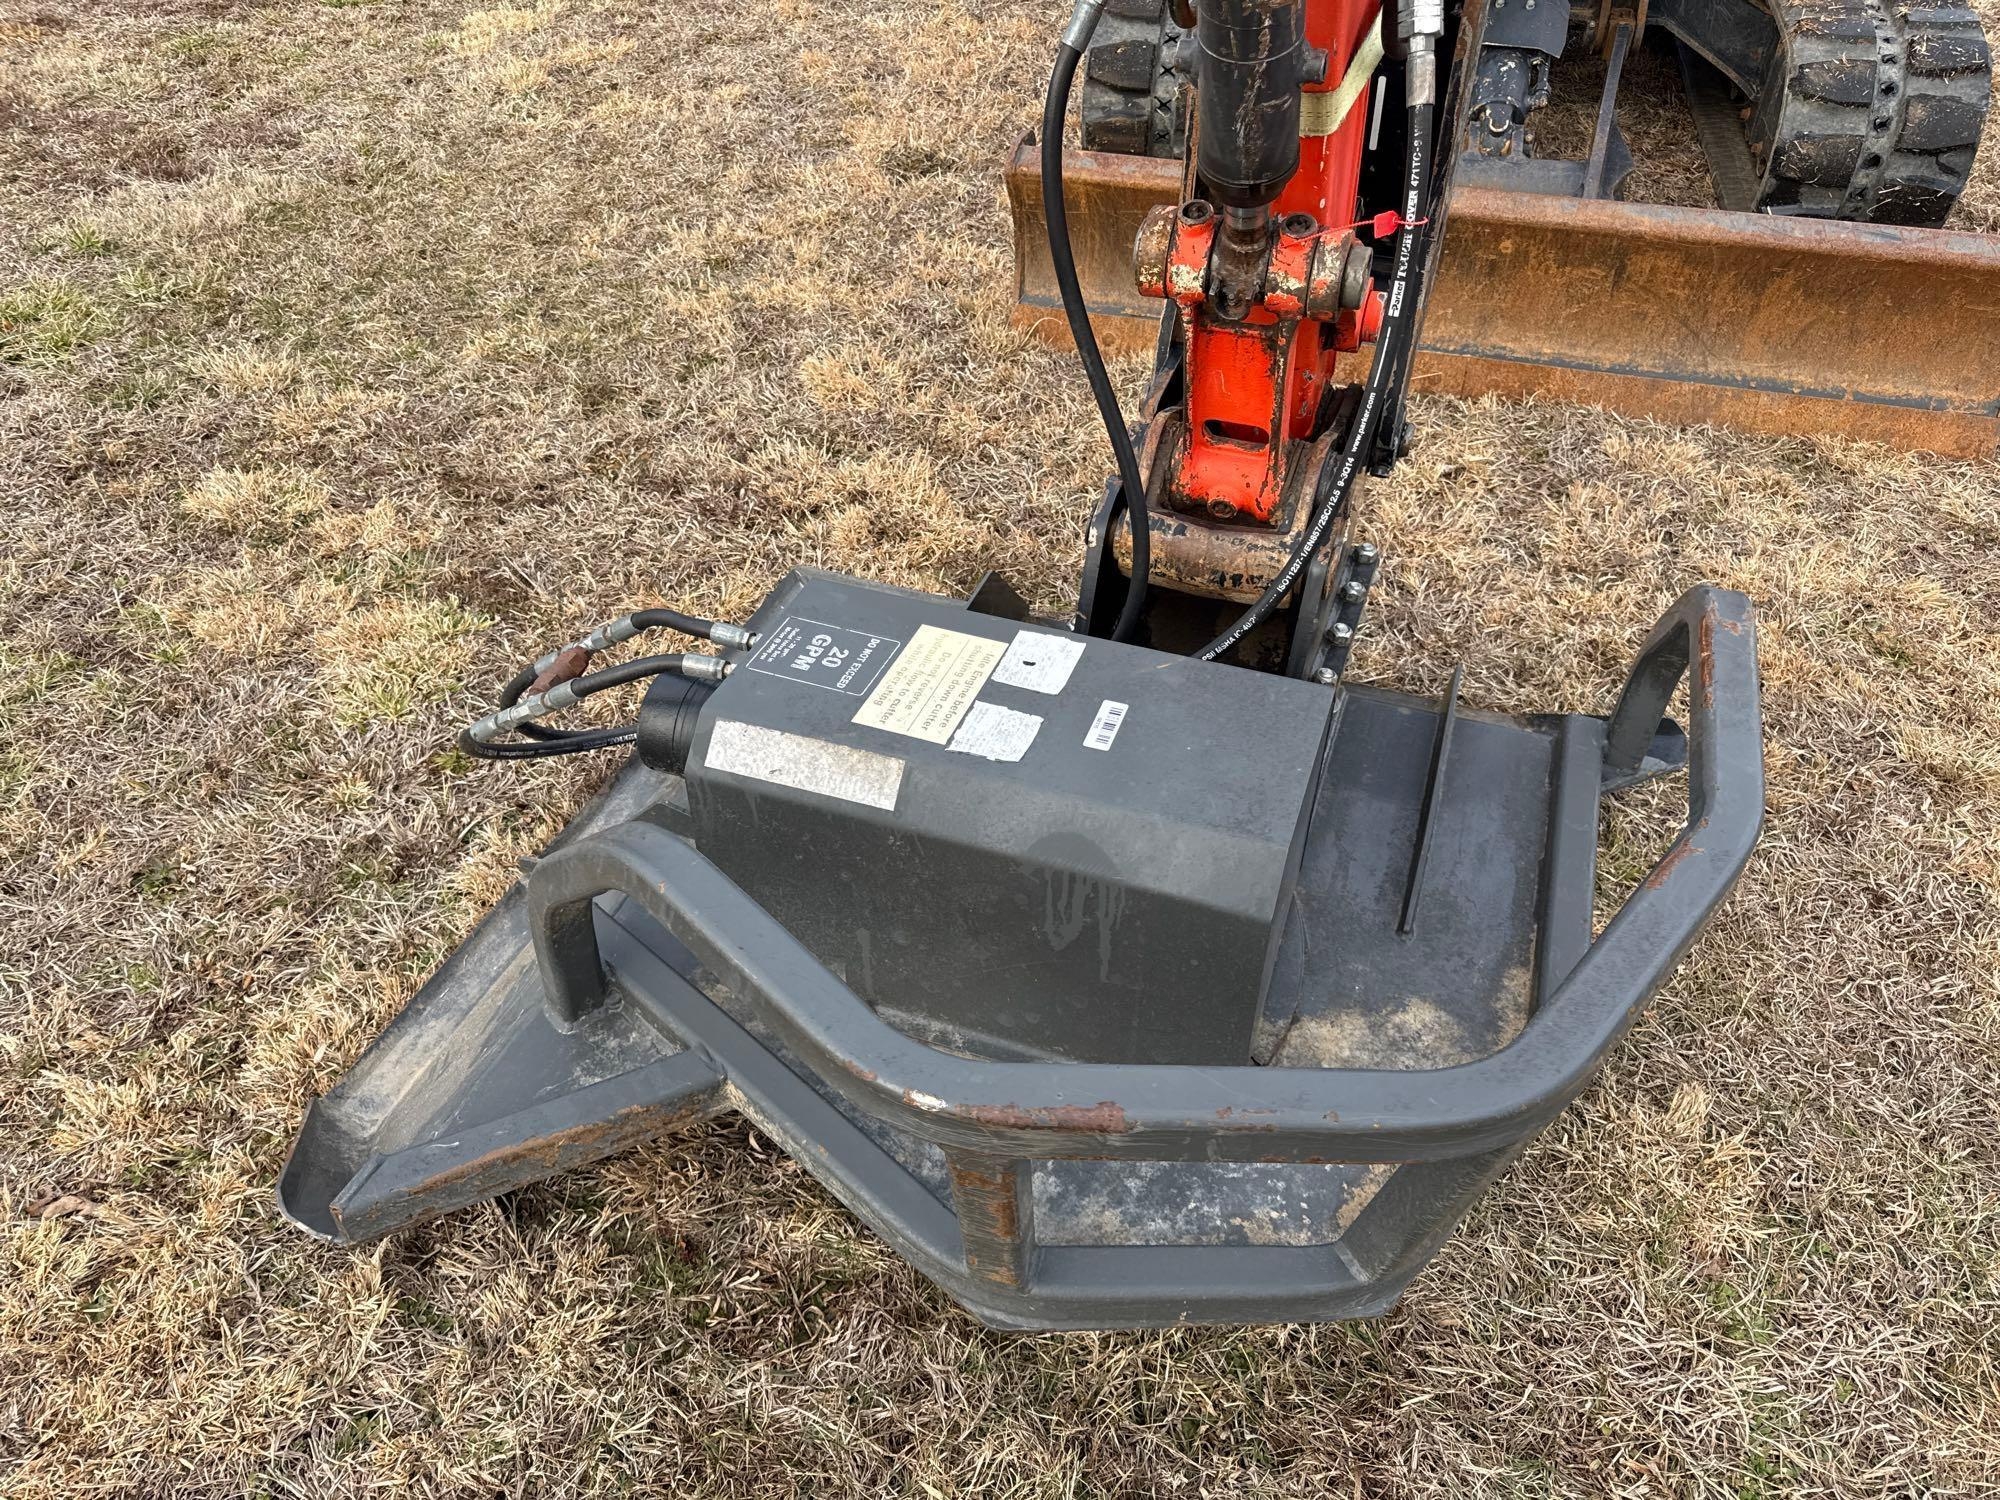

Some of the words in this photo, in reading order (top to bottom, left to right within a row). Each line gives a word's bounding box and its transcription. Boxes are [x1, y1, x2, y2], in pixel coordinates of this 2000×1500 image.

[1410, 139, 1423, 187] 471TC-8
[1405, 190, 1418, 230] COVER
[1397, 233, 1413, 279] TOUGH
[1389, 281, 1405, 316] Parker
[1215, 636, 1237, 655] MSHA
[1351, 392, 1377, 452] www.parker.com
[789, 632, 835, 671] GPM
[819, 645, 851, 669] 20
[855, 648, 872, 662] NOT
[866, 638, 881, 648] DO
[937, 651, 952, 663] Do
[834, 661, 862, 688] EXCEED
[926, 664, 942, 678] not
[953, 644, 984, 678] shutting
[977, 653, 994, 669] Idle
[897, 688, 910, 697] to
[903, 678, 931, 711] reverse
[938, 679, 961, 702] down
[955, 669, 983, 699] Engine
[877, 697, 902, 725] cutter
[920, 703, 944, 731] cutter
[938, 699, 964, 729] before
